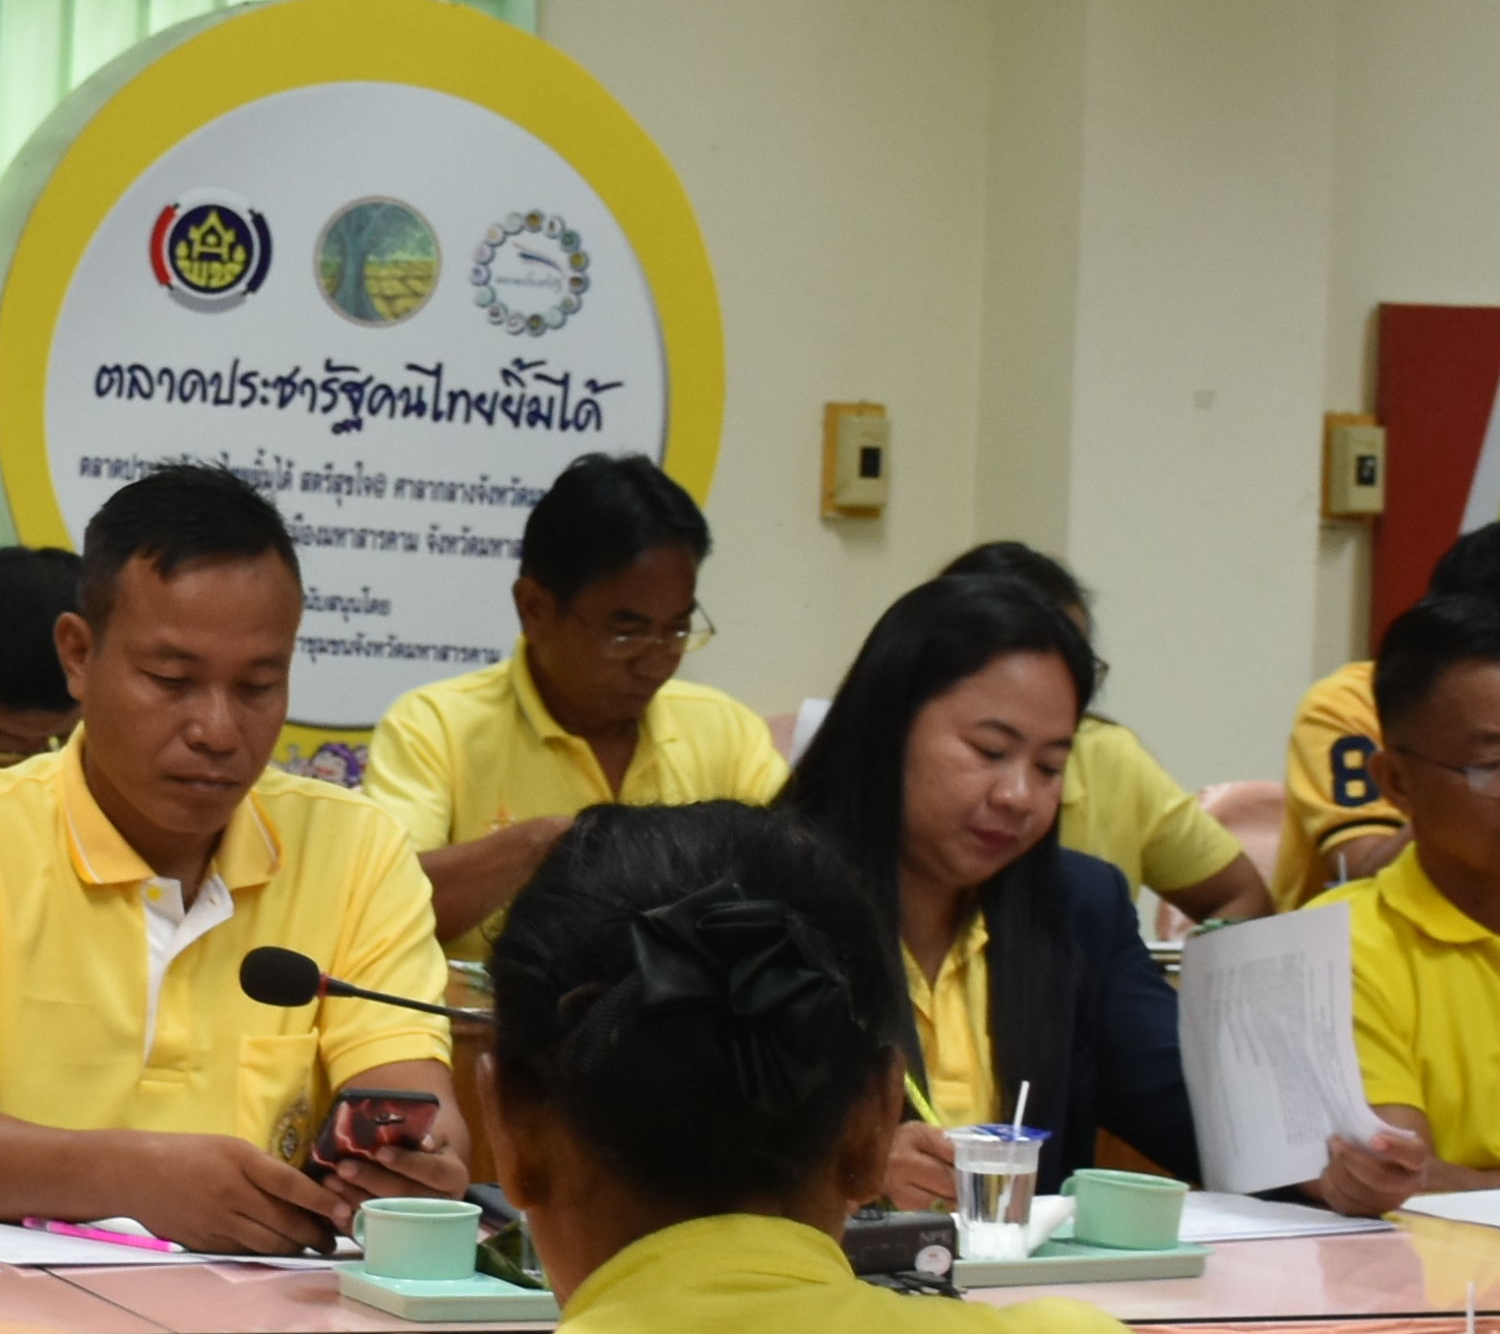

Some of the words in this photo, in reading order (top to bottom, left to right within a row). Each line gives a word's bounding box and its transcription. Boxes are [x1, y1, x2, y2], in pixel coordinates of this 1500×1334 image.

[95, 358, 624, 435] ตลาดประชารัฐคนไทยยิ้มได้
